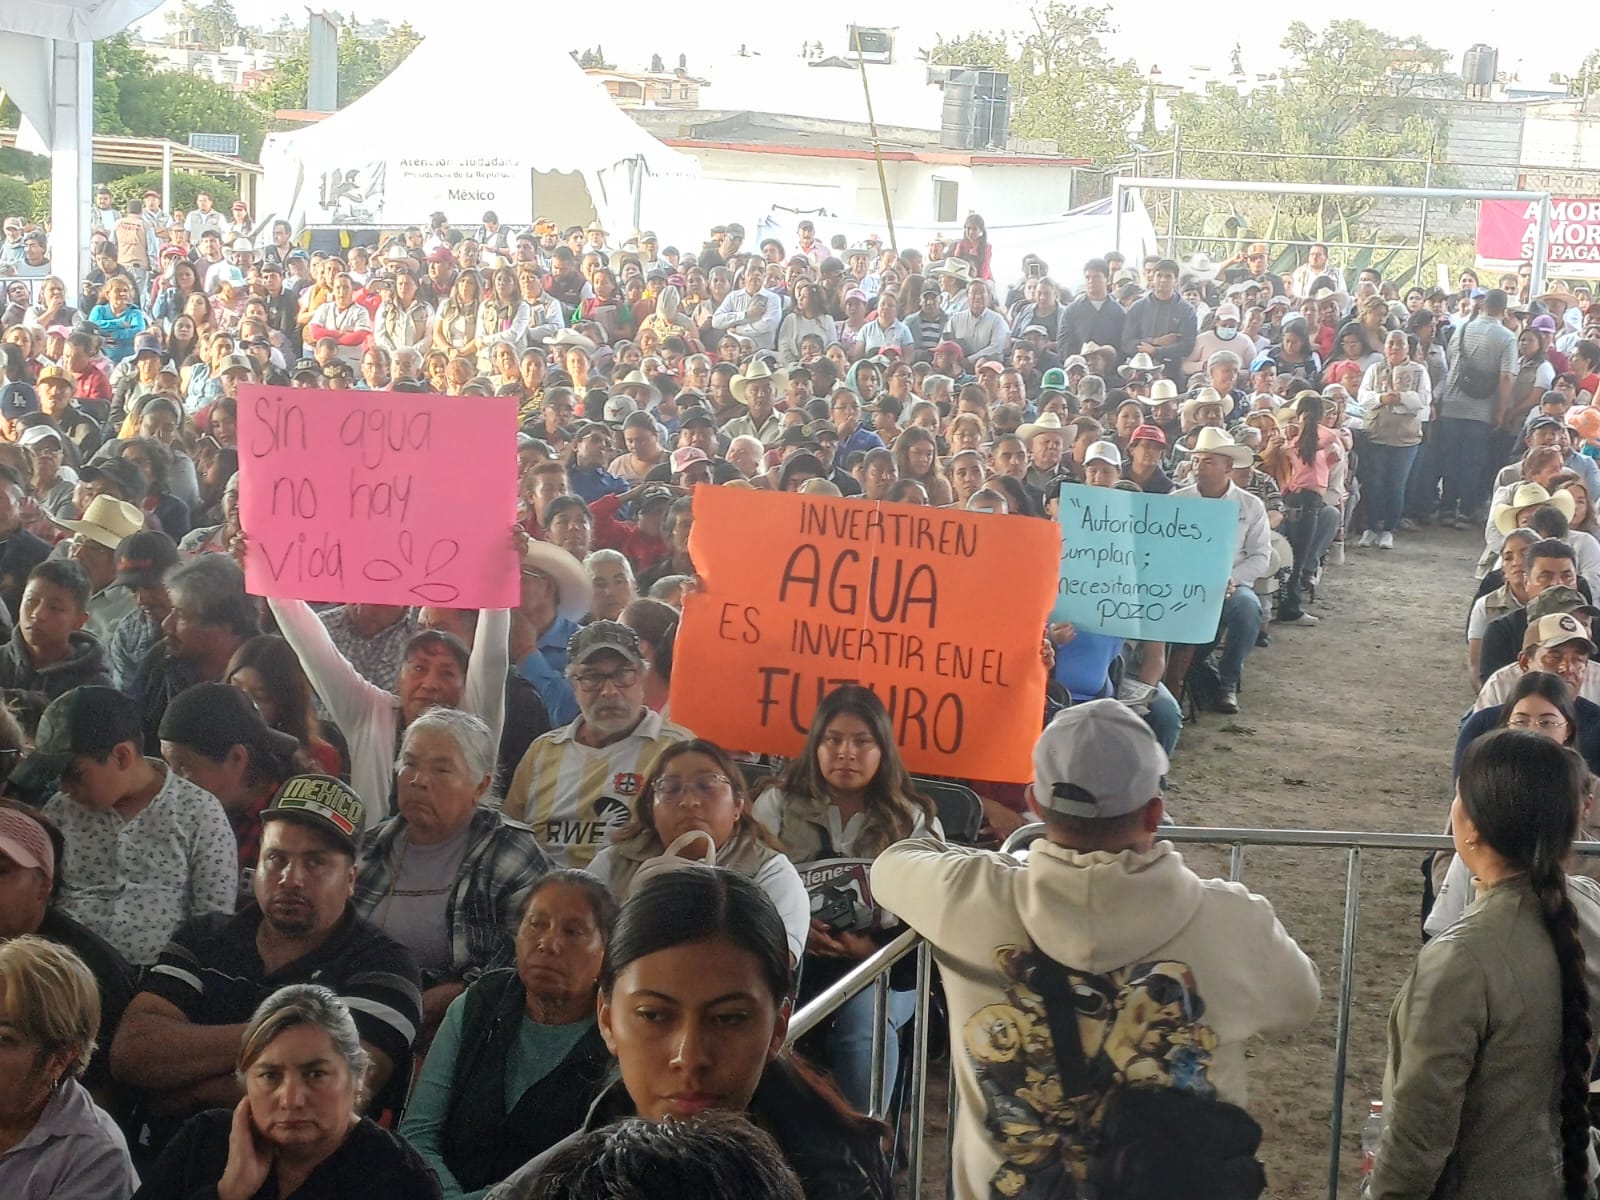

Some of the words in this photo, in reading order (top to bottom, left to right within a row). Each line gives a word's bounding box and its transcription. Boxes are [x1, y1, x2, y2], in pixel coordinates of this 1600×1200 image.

[448, 189, 495, 201] México
[1522, 201, 1600, 222] AMOR
[1521, 222, 1600, 245] AMOR
[252, 397, 307, 458] Sin
[340, 408, 432, 470] agua
[272, 477, 318, 519] no
[350, 467, 413, 523] hay
[778, 544, 938, 628] AGUA
[1058, 575, 1173, 598] necesitamos
[1183, 583, 1206, 603] un
[719, 602, 761, 645] ES
[791, 619, 925, 672] INVERTIR
[935, 642, 974, 679] EN
[981, 649, 1009, 687] EL
[283, 779, 362, 824] MEXICO
[546, 820, 608, 845] RWE
